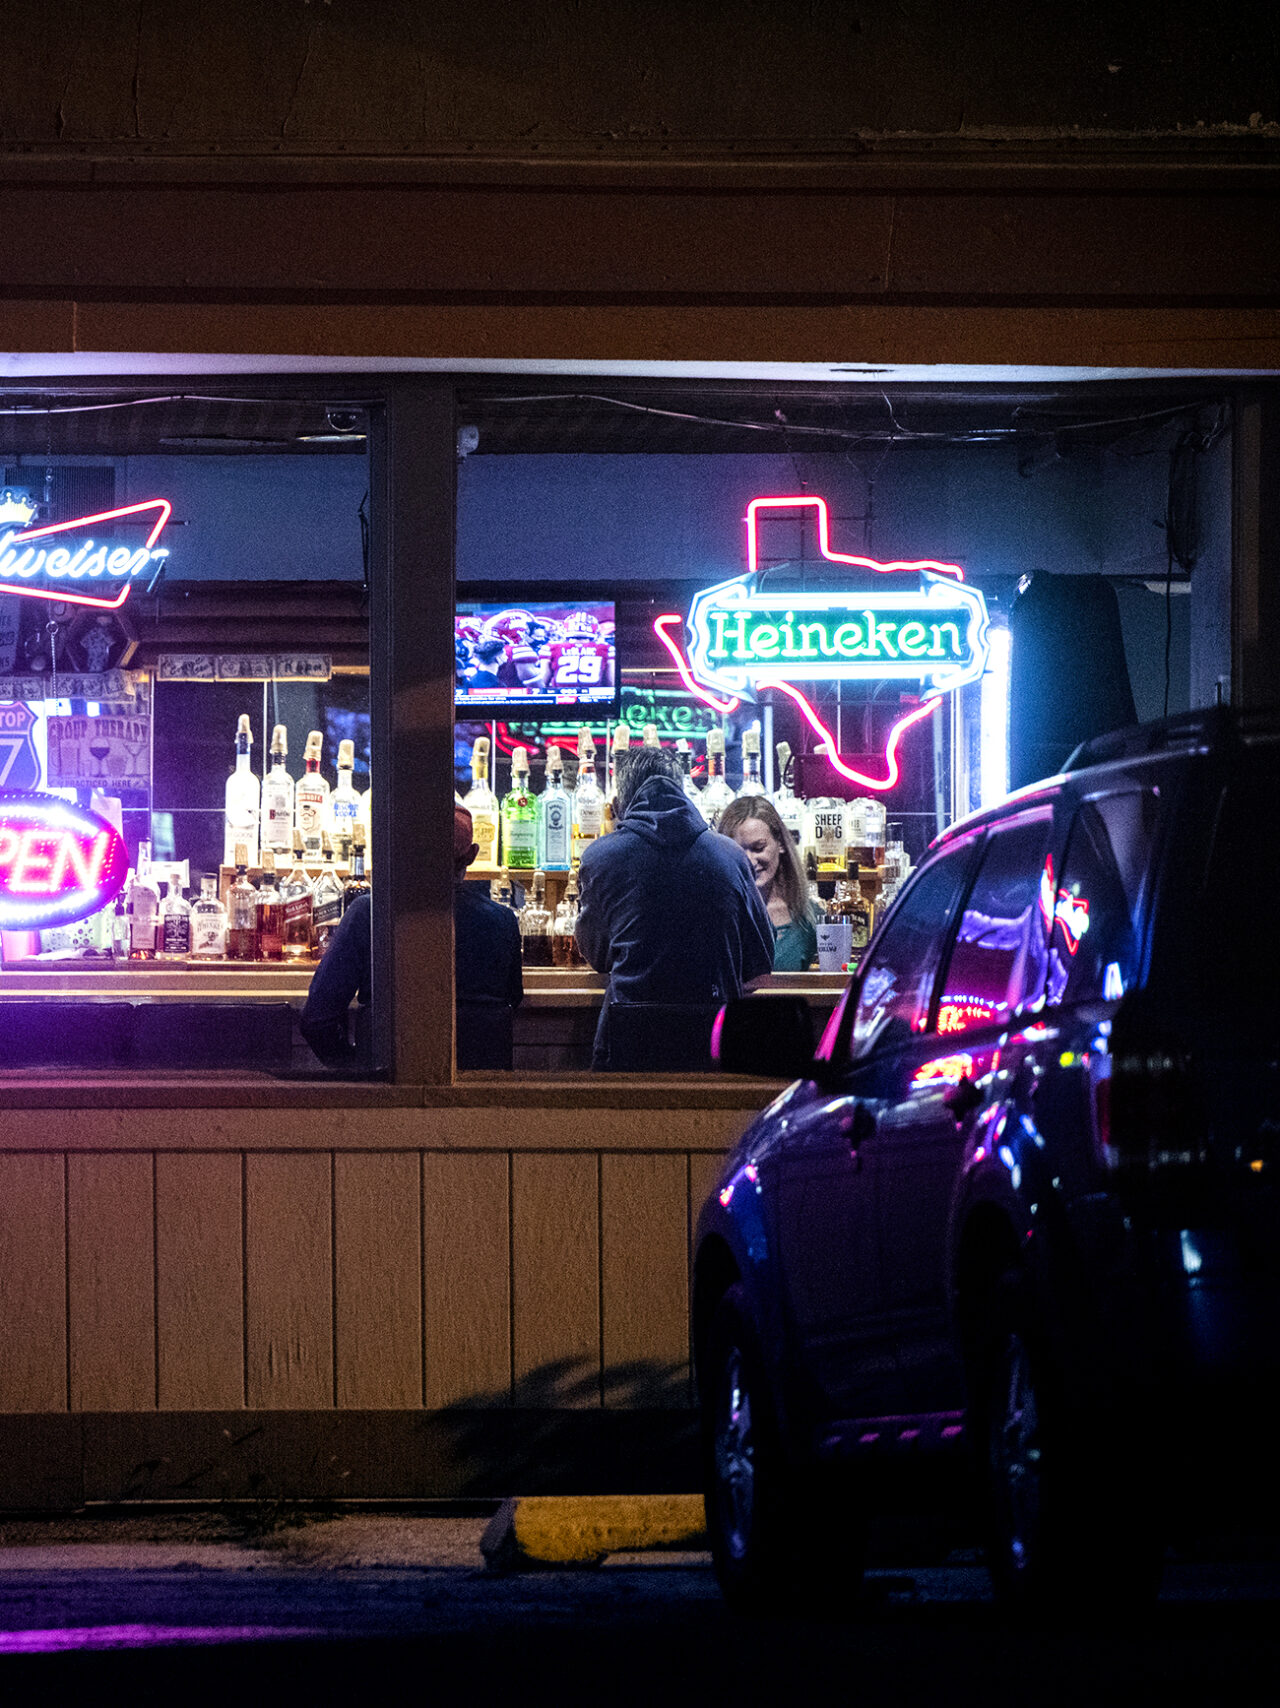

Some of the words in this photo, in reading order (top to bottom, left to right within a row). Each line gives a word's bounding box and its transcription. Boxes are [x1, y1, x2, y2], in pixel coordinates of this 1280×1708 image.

[708, 610, 962, 658] Heineken
[555, 656, 603, 683] 29
[94, 719, 150, 743] THERAPY
[815, 813, 843, 825] SHEEP
